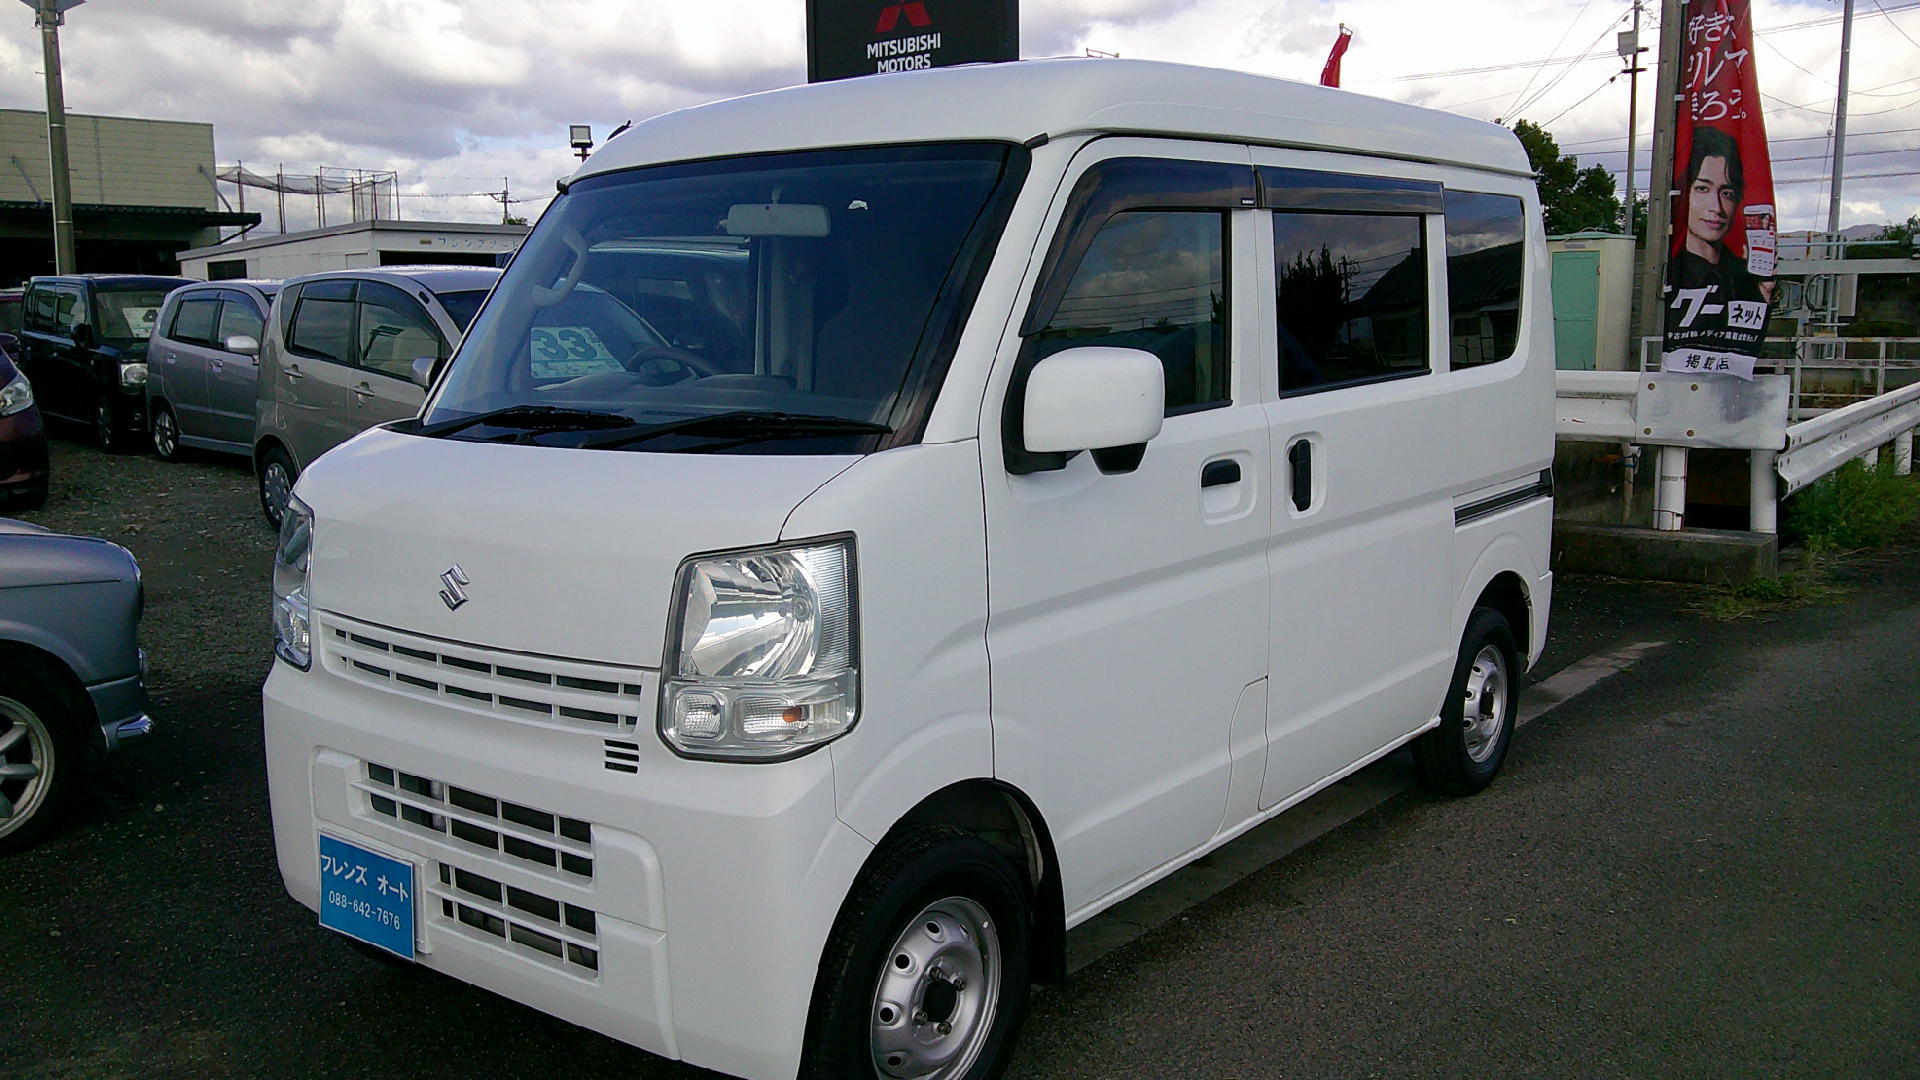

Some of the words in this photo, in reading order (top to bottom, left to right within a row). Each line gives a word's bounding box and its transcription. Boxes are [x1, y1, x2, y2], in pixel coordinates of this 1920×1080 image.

[866, 32, 942, 58] MITSUBISHI
[877, 53, 931, 74] MOTORS
[1670, 284, 1725, 328] グー
[1731, 303, 1763, 326] ネット
[1685, 353, 1730, 370] 掲載店
[320, 854, 368, 886] フレンズ
[377, 875, 409, 902] オート
[328, 890, 401, 930] 088-642-7676
